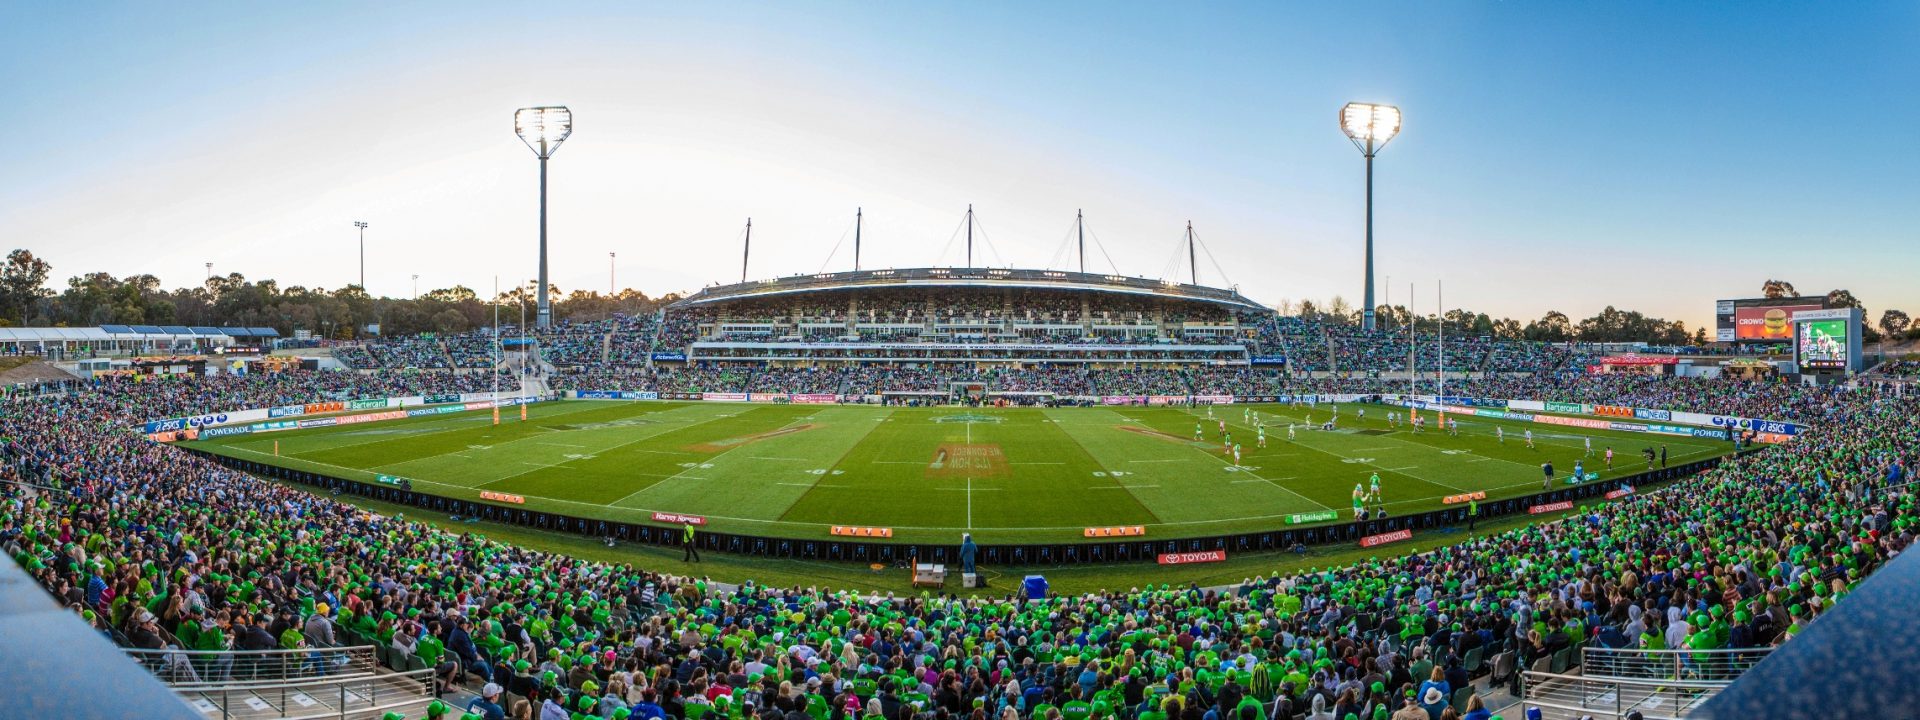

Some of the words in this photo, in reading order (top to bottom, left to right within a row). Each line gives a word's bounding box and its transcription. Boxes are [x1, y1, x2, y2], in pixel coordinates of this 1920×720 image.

[635, 391, 657, 399] NEWS
[352, 400, 387, 410] Bartercard
[1546, 402, 1580, 413] Bartercard
[271, 408, 284, 416] WIN
[1635, 409, 1649, 418] WIN
[204, 426, 250, 436] POWERADE
[1768, 422, 1786, 433] asics
[950, 457, 970, 469] HOW
[1545, 503, 1569, 511] TOYOTA
[656, 512, 676, 522] Harvey
[1302, 513, 1323, 521] Holiday
[1379, 531, 1407, 544] TOYOTA
[1181, 552, 1219, 562] TOYOTA
